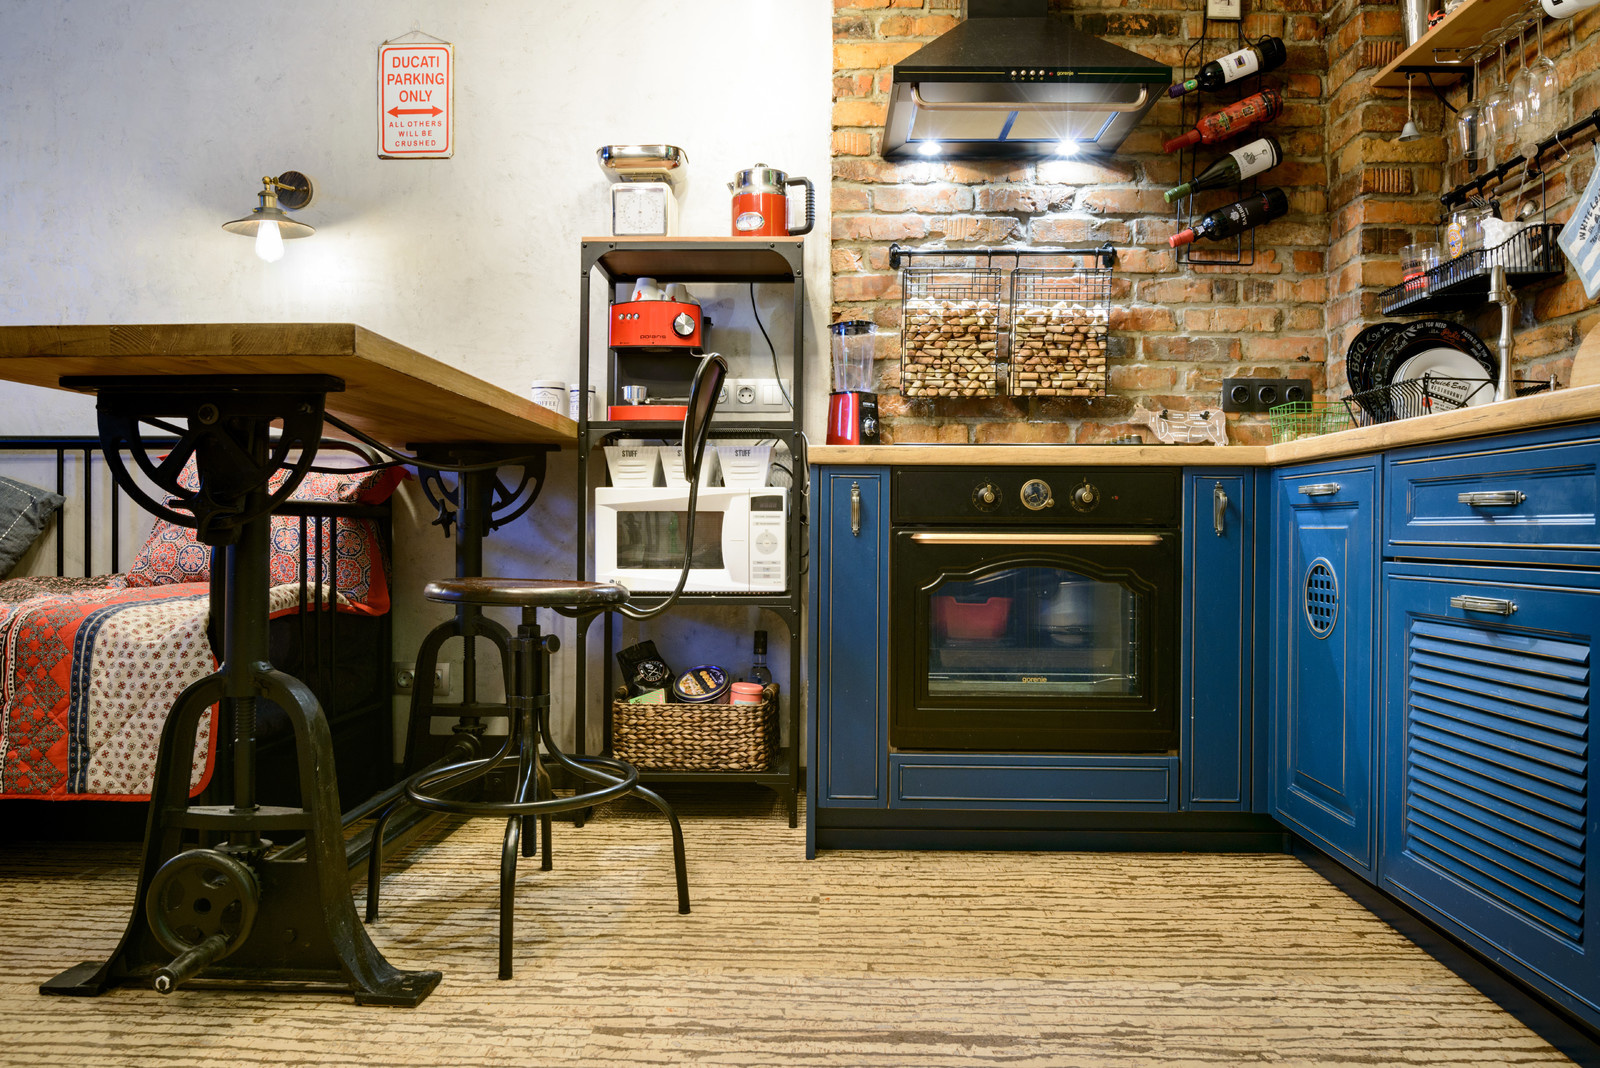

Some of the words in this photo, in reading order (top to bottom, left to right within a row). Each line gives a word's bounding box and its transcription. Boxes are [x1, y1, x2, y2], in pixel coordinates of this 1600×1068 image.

[392, 56, 440, 68] DUCATI
[386, 73, 445, 85] PARKING
[399, 90, 433, 102] ONLY
[395, 139, 436, 147] CRUSHED
[1352, 342, 1368, 373] BBQ
[734, 449, 751, 457] STUFF
